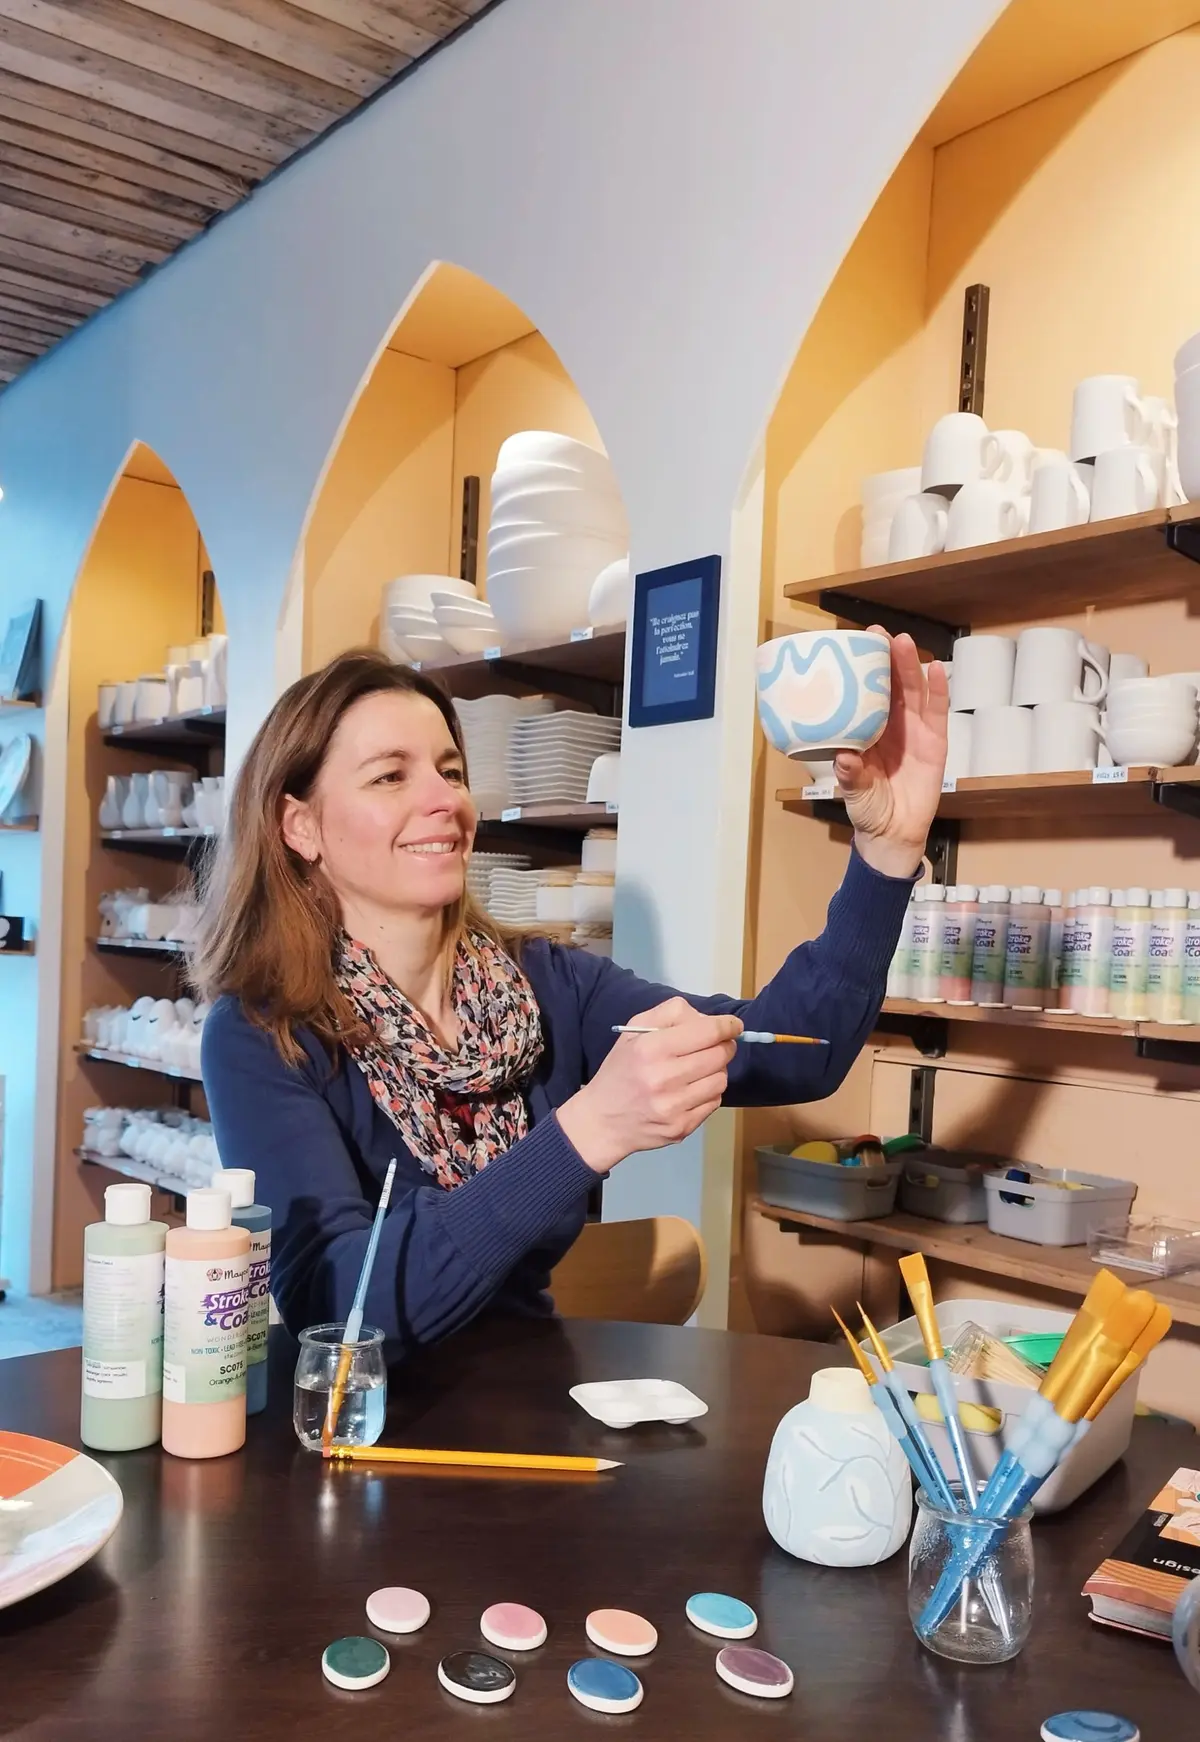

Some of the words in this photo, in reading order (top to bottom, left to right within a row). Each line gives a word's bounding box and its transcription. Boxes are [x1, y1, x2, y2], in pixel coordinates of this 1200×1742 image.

[204, 1311, 218, 1326] &
[220, 1310, 248, 1331] Coa
[205, 1346, 220, 1354] TOXIC
[224, 1343, 236, 1352] LEAD
[220, 1360, 244, 1375] SC075
[1153, 1557, 1200, 1575] esign
